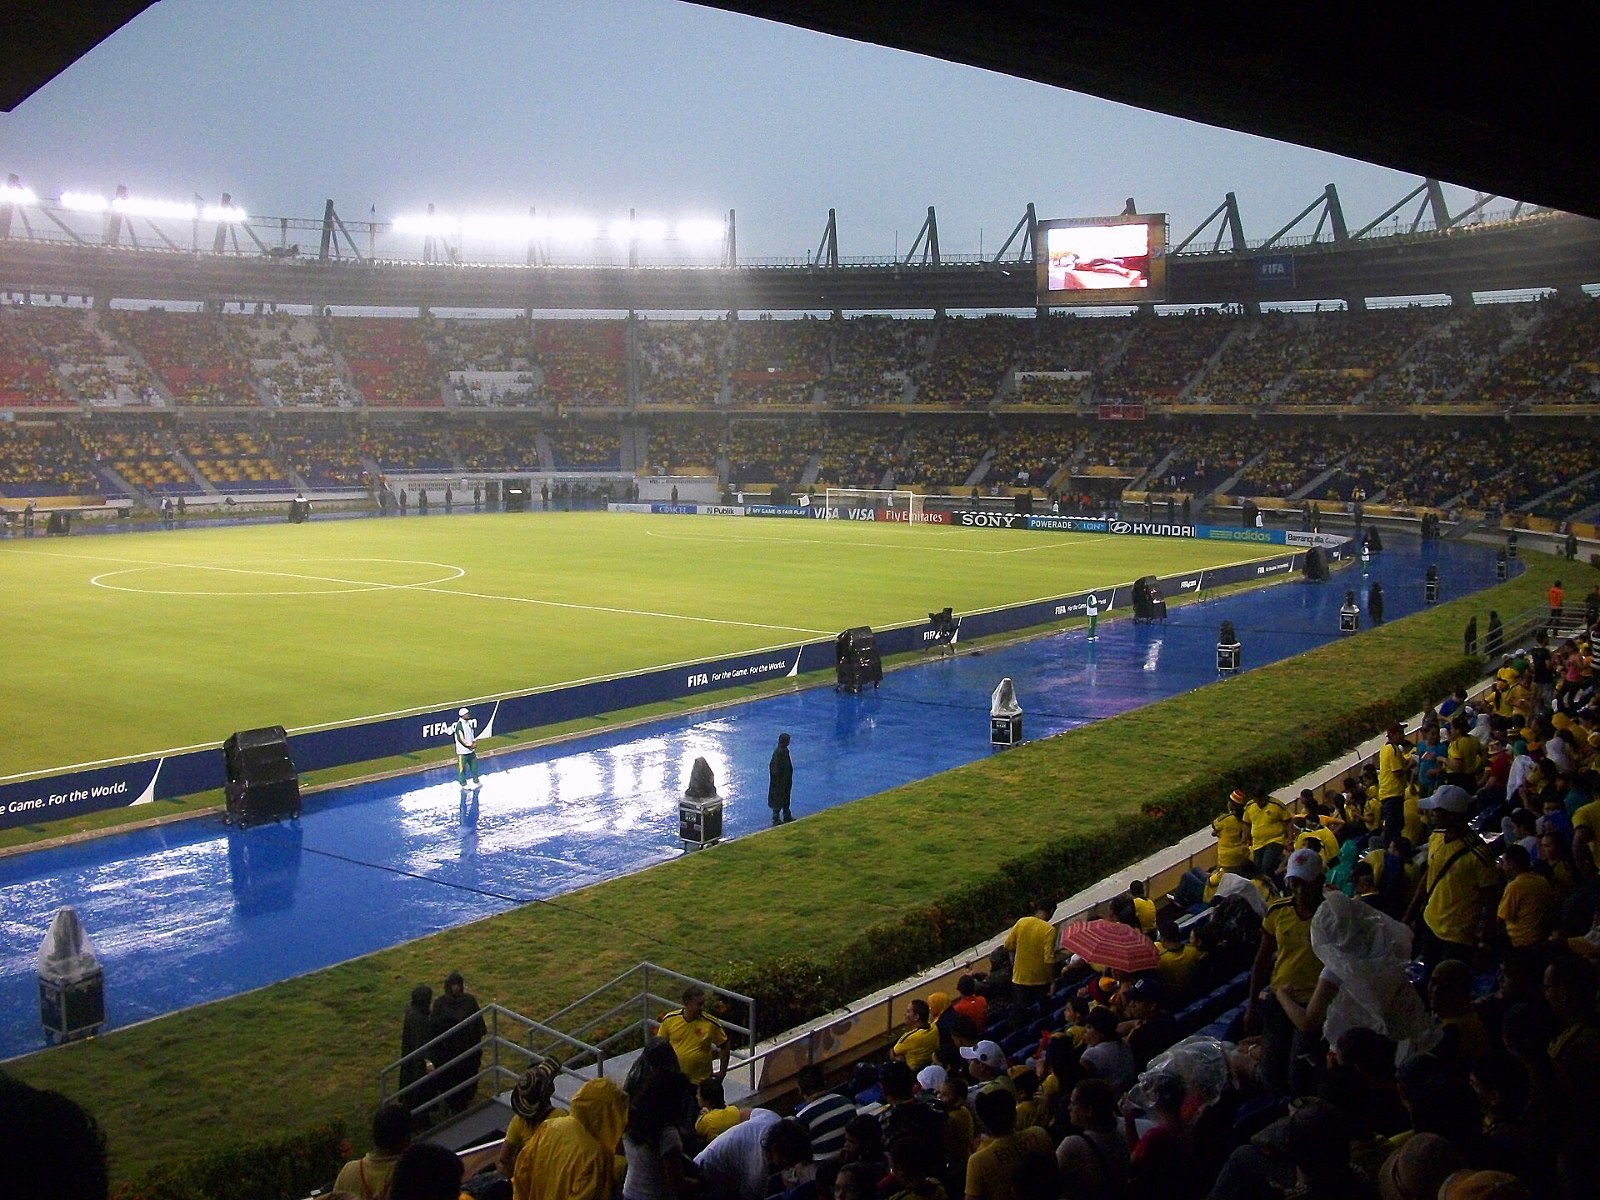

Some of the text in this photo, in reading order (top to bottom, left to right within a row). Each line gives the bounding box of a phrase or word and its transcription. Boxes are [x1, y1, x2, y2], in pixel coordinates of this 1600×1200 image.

[1262, 263, 1284, 275] FIFA
[714, 507, 735, 515] Publik
[813, 507, 840, 519] VISA
[846, 508, 875, 521] VISA
[886, 510, 943, 522] Fly Emirates
[962, 513, 1016, 527] SONY
[1031, 519, 1072, 529] POWERADE
[1133, 523, 1195, 537] HYUNDAI
[1233, 530, 1271, 542] adidas
[1288, 534, 1324, 546] Barranquilla
[688, 673, 709, 688] FIFA
[712, 673, 722, 682] For
[722, 671, 731, 680] the
[732, 668, 749, 678] Game.
[750, 667, 759, 675] For
[759, 665, 768, 673] the
[8, 797, 46, 814] Game.
[47, 794, 67, 807] For
[69, 789, 89, 803] the
[91, 781, 129, 799] World.
